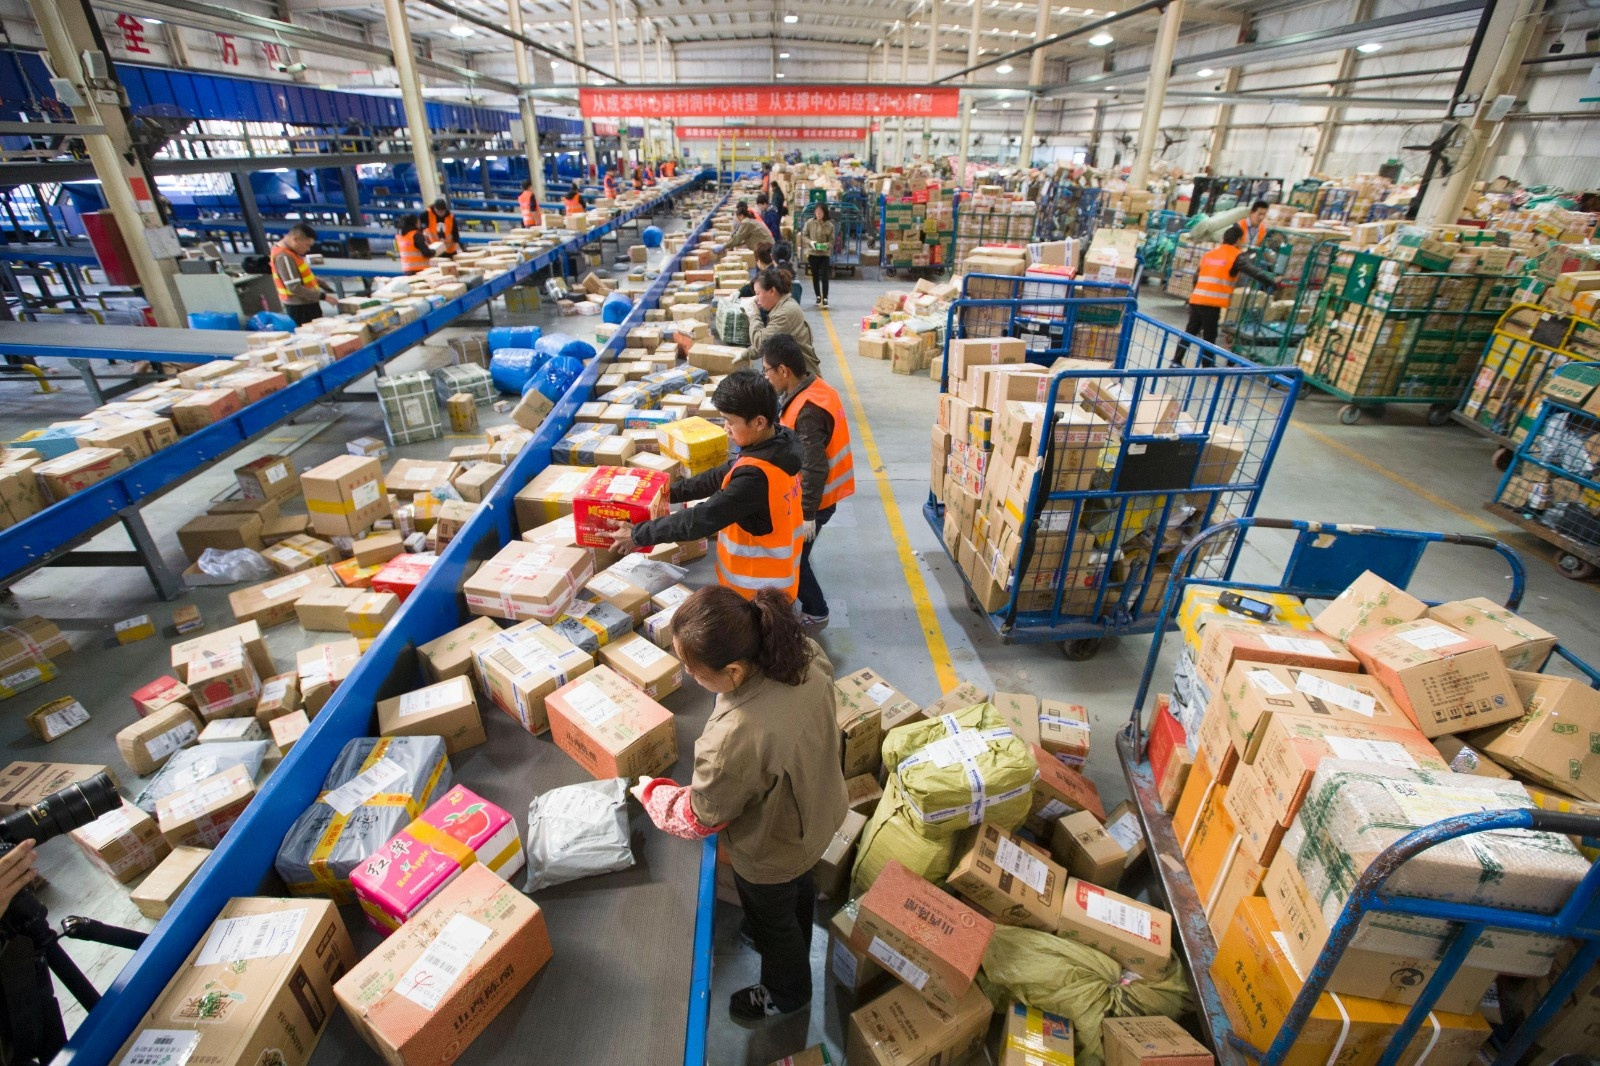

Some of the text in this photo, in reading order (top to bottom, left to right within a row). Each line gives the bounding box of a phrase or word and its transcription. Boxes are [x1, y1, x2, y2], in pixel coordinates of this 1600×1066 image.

[115, 13, 150, 54] 全
[593, 92, 933, 112] 从成本中心向利润中心转型 从支撑中心向经营中心转型
[396, 850, 430, 888] Red Apple
[903, 897, 955, 935] 山西陈醋
[453, 963, 515, 1030] 山西陈醋
